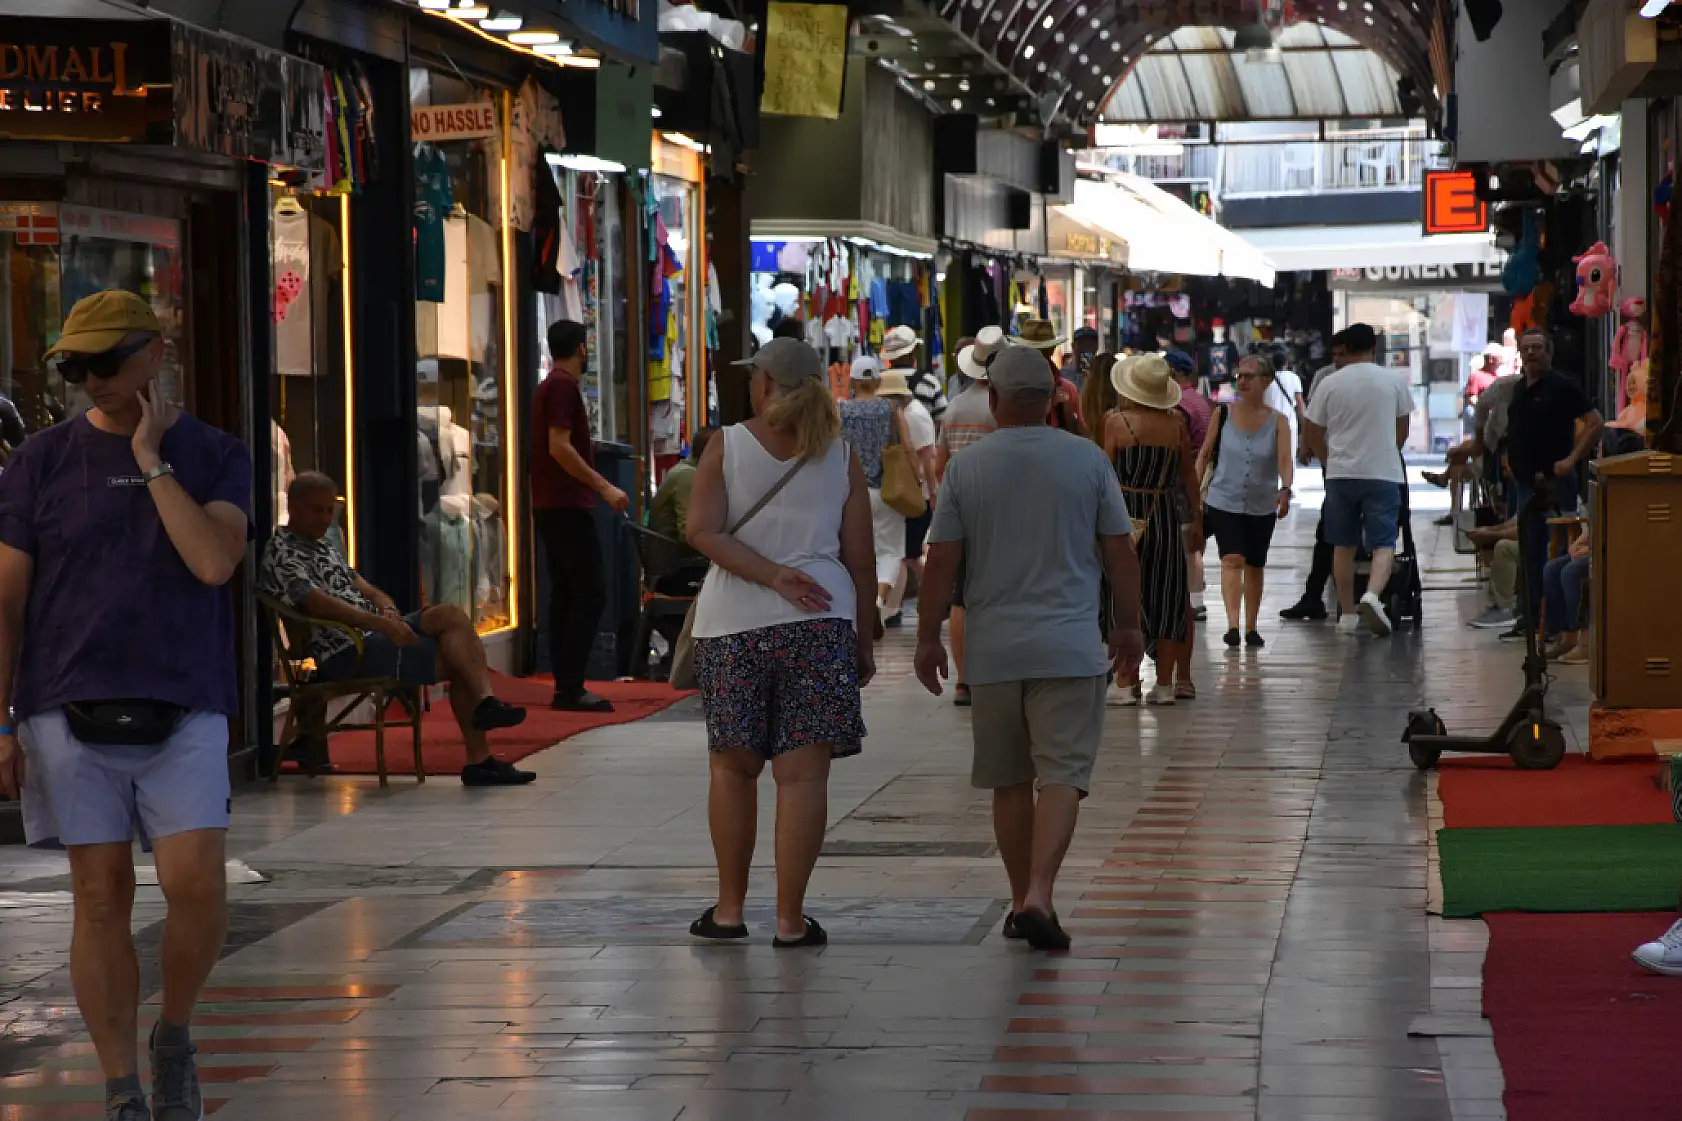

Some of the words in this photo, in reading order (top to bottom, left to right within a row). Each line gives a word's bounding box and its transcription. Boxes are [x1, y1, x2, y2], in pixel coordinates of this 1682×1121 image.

[412, 111, 430, 134] NO
[434, 108, 493, 133] HASSLE
[1434, 177, 1477, 226] E
